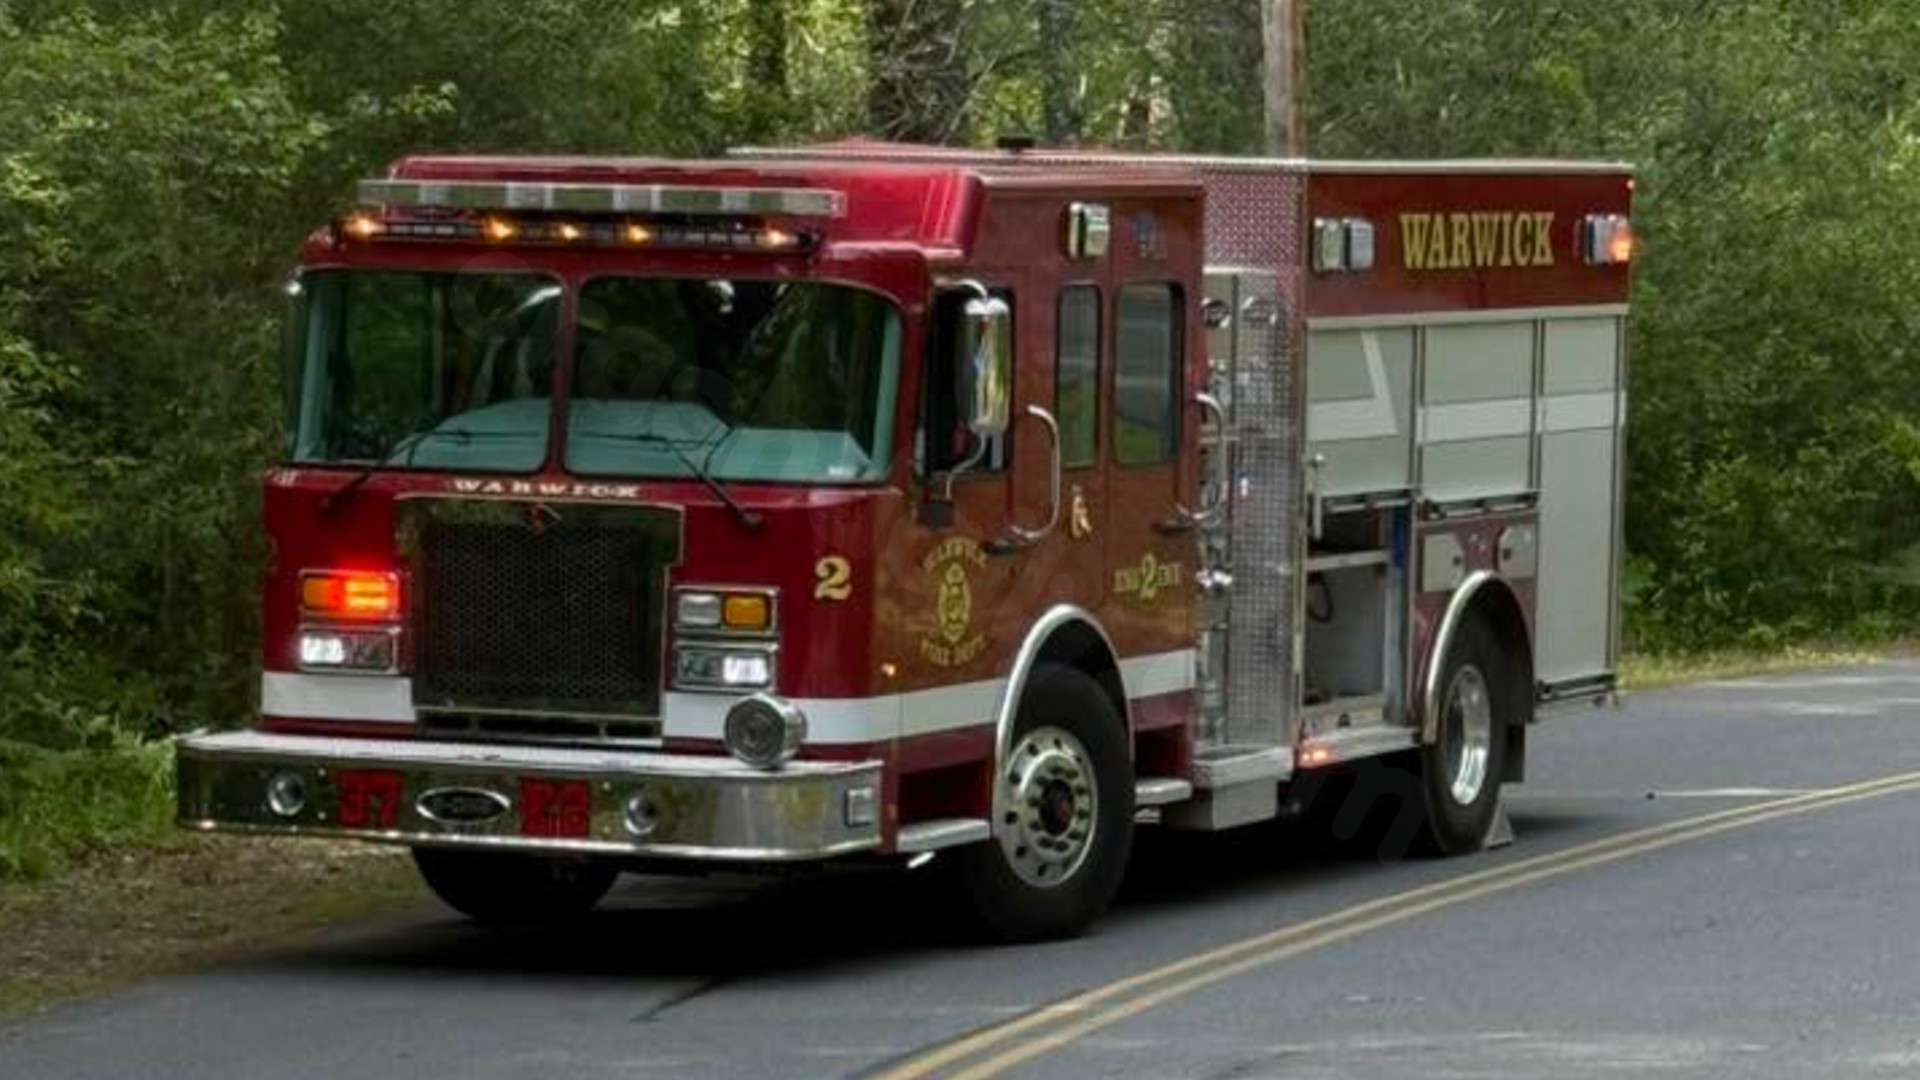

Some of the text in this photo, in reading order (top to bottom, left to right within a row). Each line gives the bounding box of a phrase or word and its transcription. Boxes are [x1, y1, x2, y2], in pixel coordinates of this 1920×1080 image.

[1399, 211, 1555, 269] WARWICK
[453, 477, 641, 498] WARWICK
[814, 555, 853, 601] 2
[337, 768, 402, 829] 37
